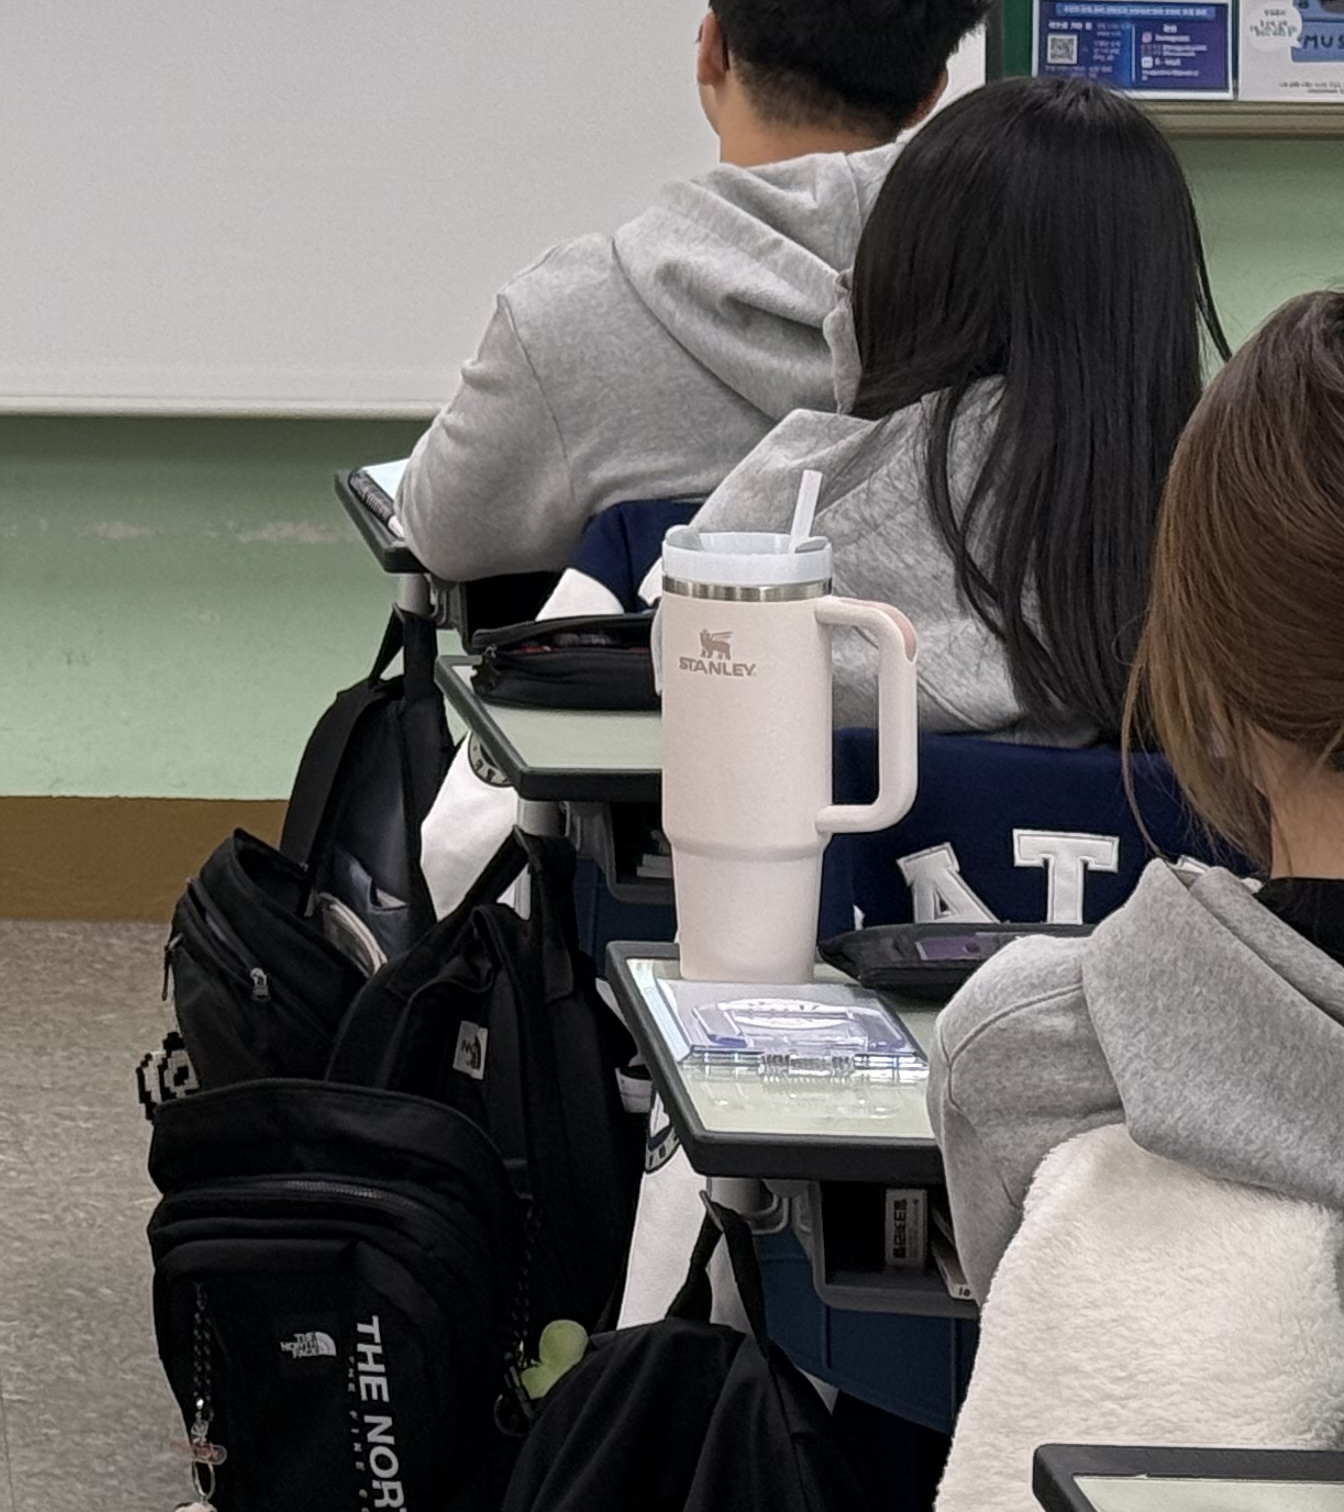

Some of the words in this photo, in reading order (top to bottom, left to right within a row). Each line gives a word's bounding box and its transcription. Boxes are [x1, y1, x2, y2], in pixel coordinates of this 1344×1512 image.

[678, 655, 757, 678] STANLEY
[356, 1315, 390, 1403] THE
[363, 1414, 408, 1512] NOR
